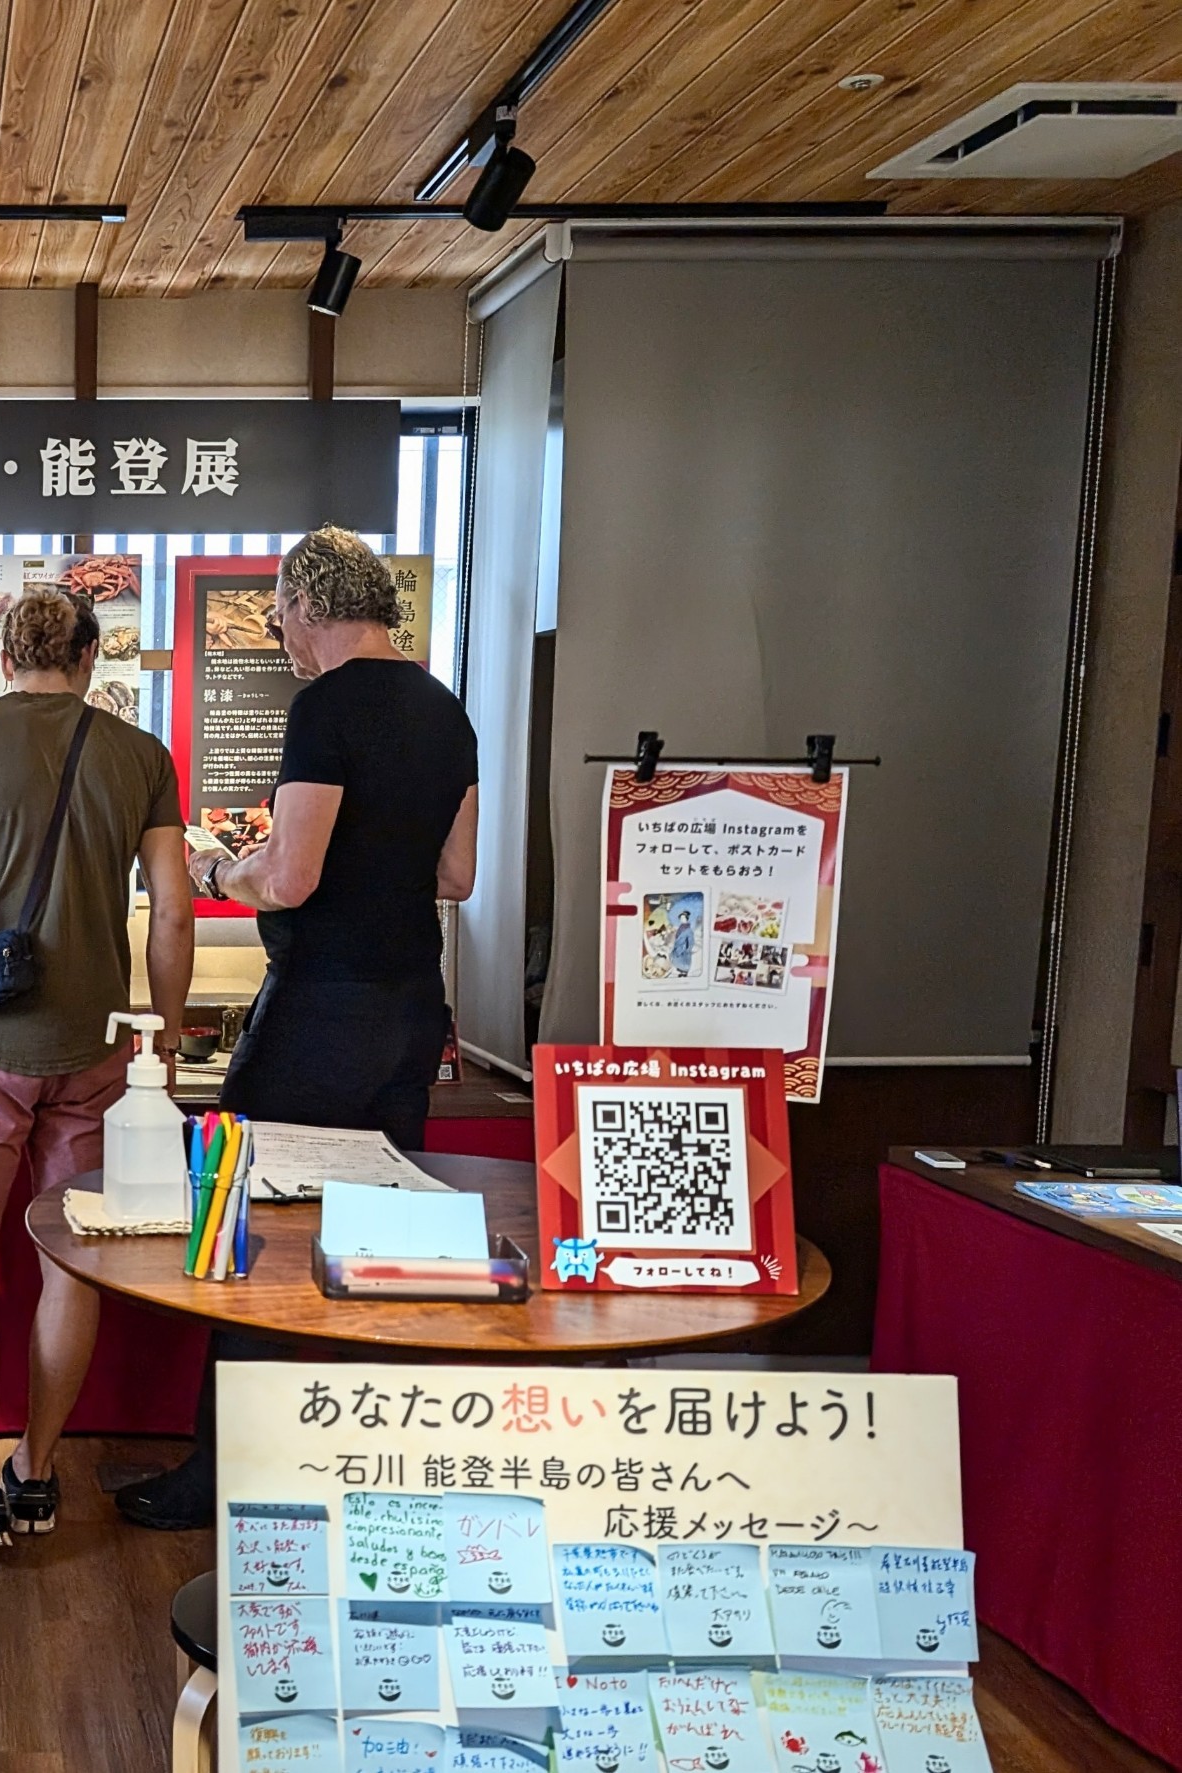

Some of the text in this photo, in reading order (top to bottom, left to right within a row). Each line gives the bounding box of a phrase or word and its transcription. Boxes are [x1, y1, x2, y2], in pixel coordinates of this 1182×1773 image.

[393, 569, 418, 652] 輪島塗
[637, 821, 717, 835] いちばの広場
[636, 843, 806, 856] フォローして、ポストカード
[660, 864, 775, 877] セットをもらおう！
[554, 1060, 766, 1080] いちばの広場 Instagram
[633, 1266, 734, 1278] フォローしてね！
[299, 1380, 877, 1440] あなたの想いを届けよう！
[423, 1454, 751, 1492] 能登半島の皆さんへ
[585, 1676, 628, 1690] Noto
